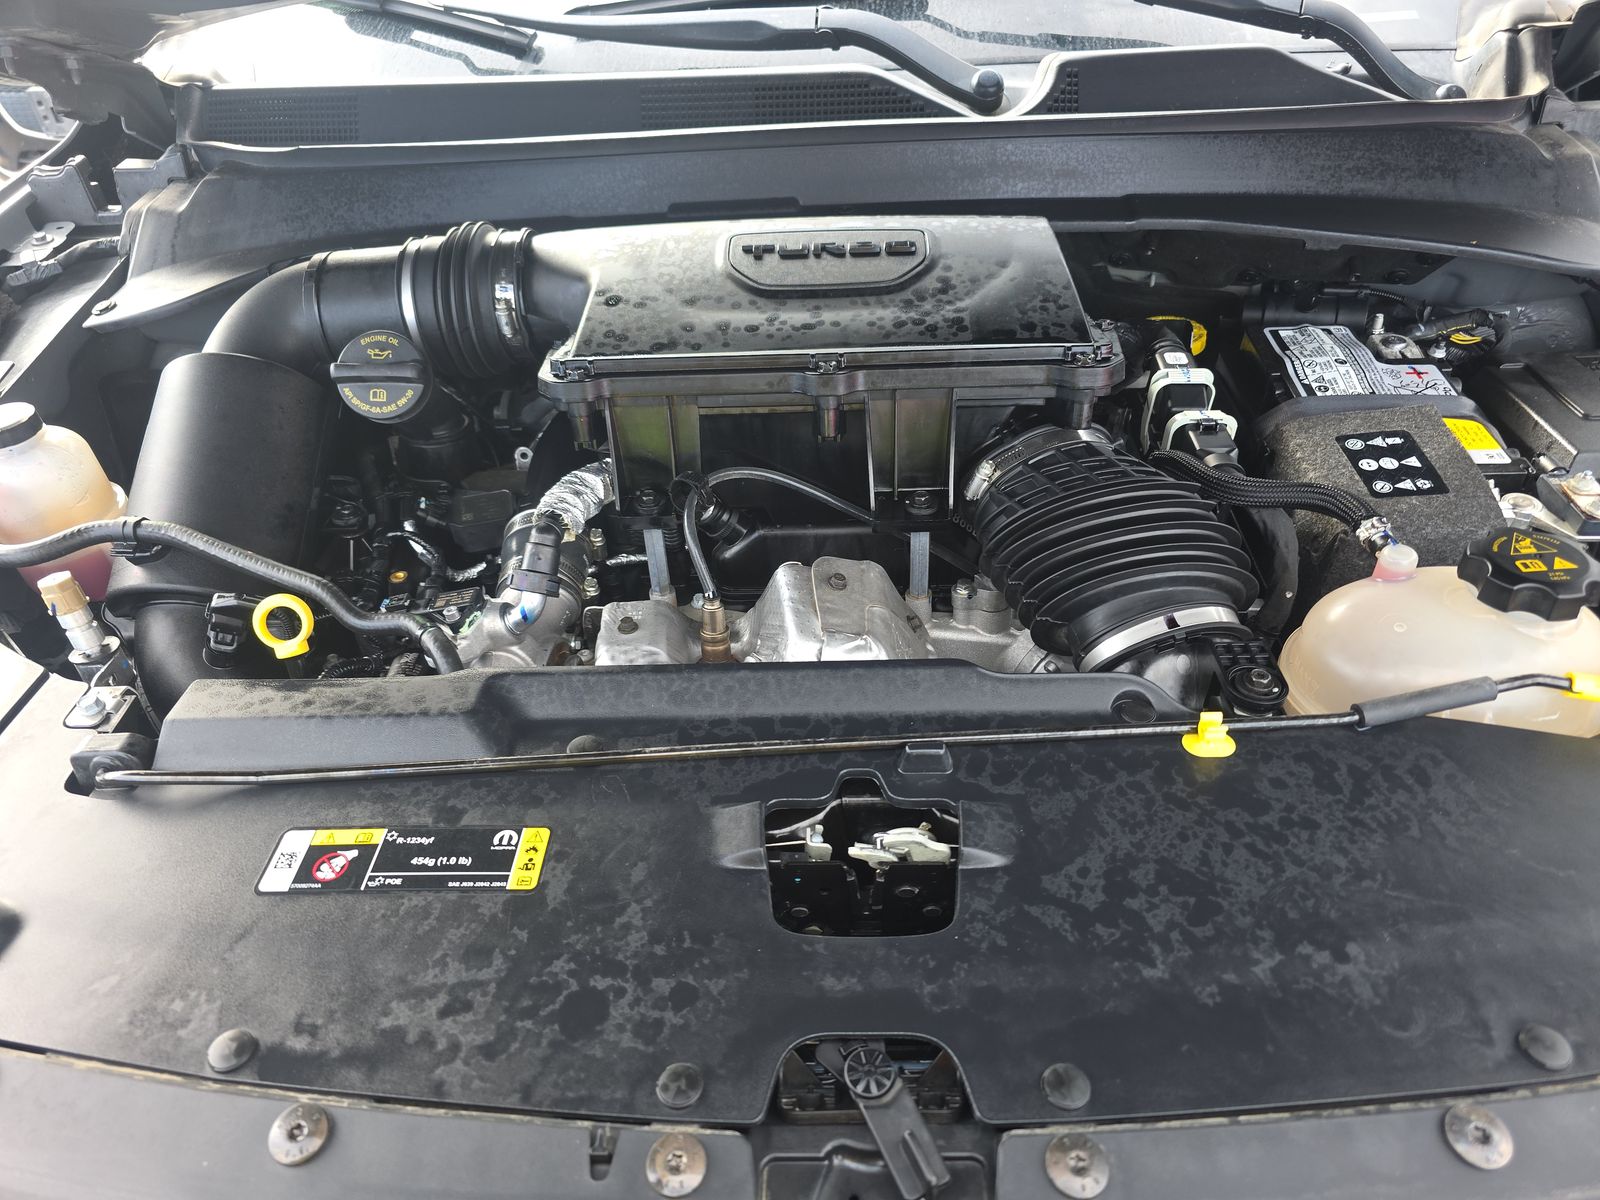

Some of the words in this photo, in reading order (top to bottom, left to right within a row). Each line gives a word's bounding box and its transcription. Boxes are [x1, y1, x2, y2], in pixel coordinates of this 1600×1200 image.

[742, 241, 917, 260] TURBO
[360, 335, 387, 346] ENGINE
[388, 336, 399, 346] OIL
[342, 387, 354, 399] API
[397, 389, 414, 407] 5W-30
[396, 836, 435, 845] R-1234yf
[410, 857, 436, 867] 454g
[437, 856, 457, 867] (1.0
[458, 856, 472, 867] lb)
